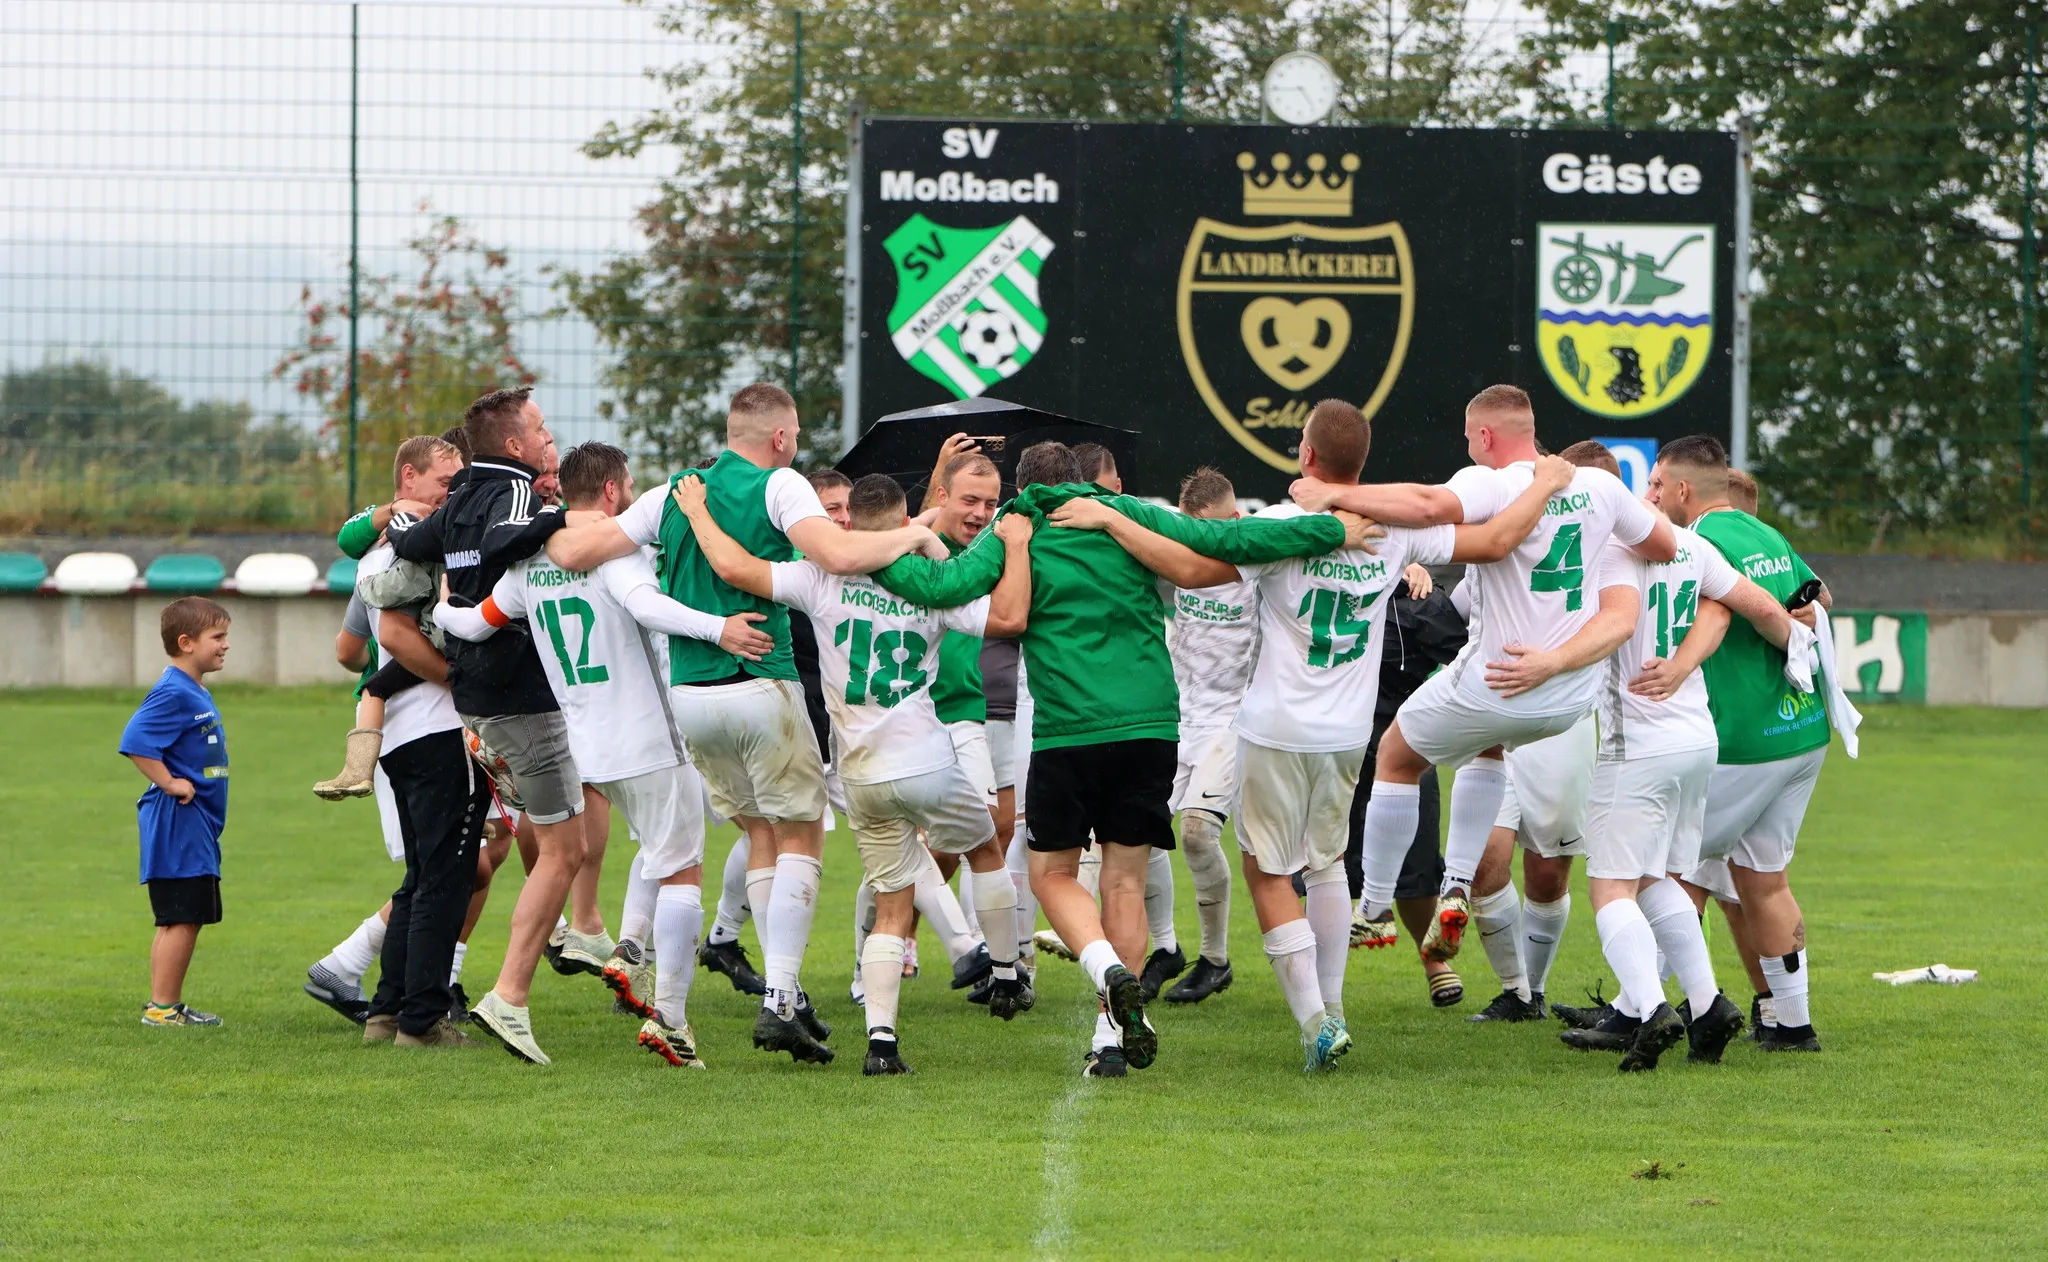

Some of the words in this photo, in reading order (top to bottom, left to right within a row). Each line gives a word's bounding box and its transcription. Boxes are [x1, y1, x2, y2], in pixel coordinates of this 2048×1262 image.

[941, 128, 999, 159] SV
[1542, 152, 1702, 195] Gäste
[880, 170, 1059, 203] Moßbach
[903, 231, 948, 282] SV
[1200, 248, 1397, 278] LANDBÄCKEREI
[911, 265, 989, 339] Moßbach
[1530, 522, 1584, 612] 4
[1204, 598, 1229, 614] FÜR
[1297, 588, 1384, 669] 15
[1648, 580, 1697, 659] 14
[535, 596, 610, 687] 12
[834, 617, 928, 709] 18
